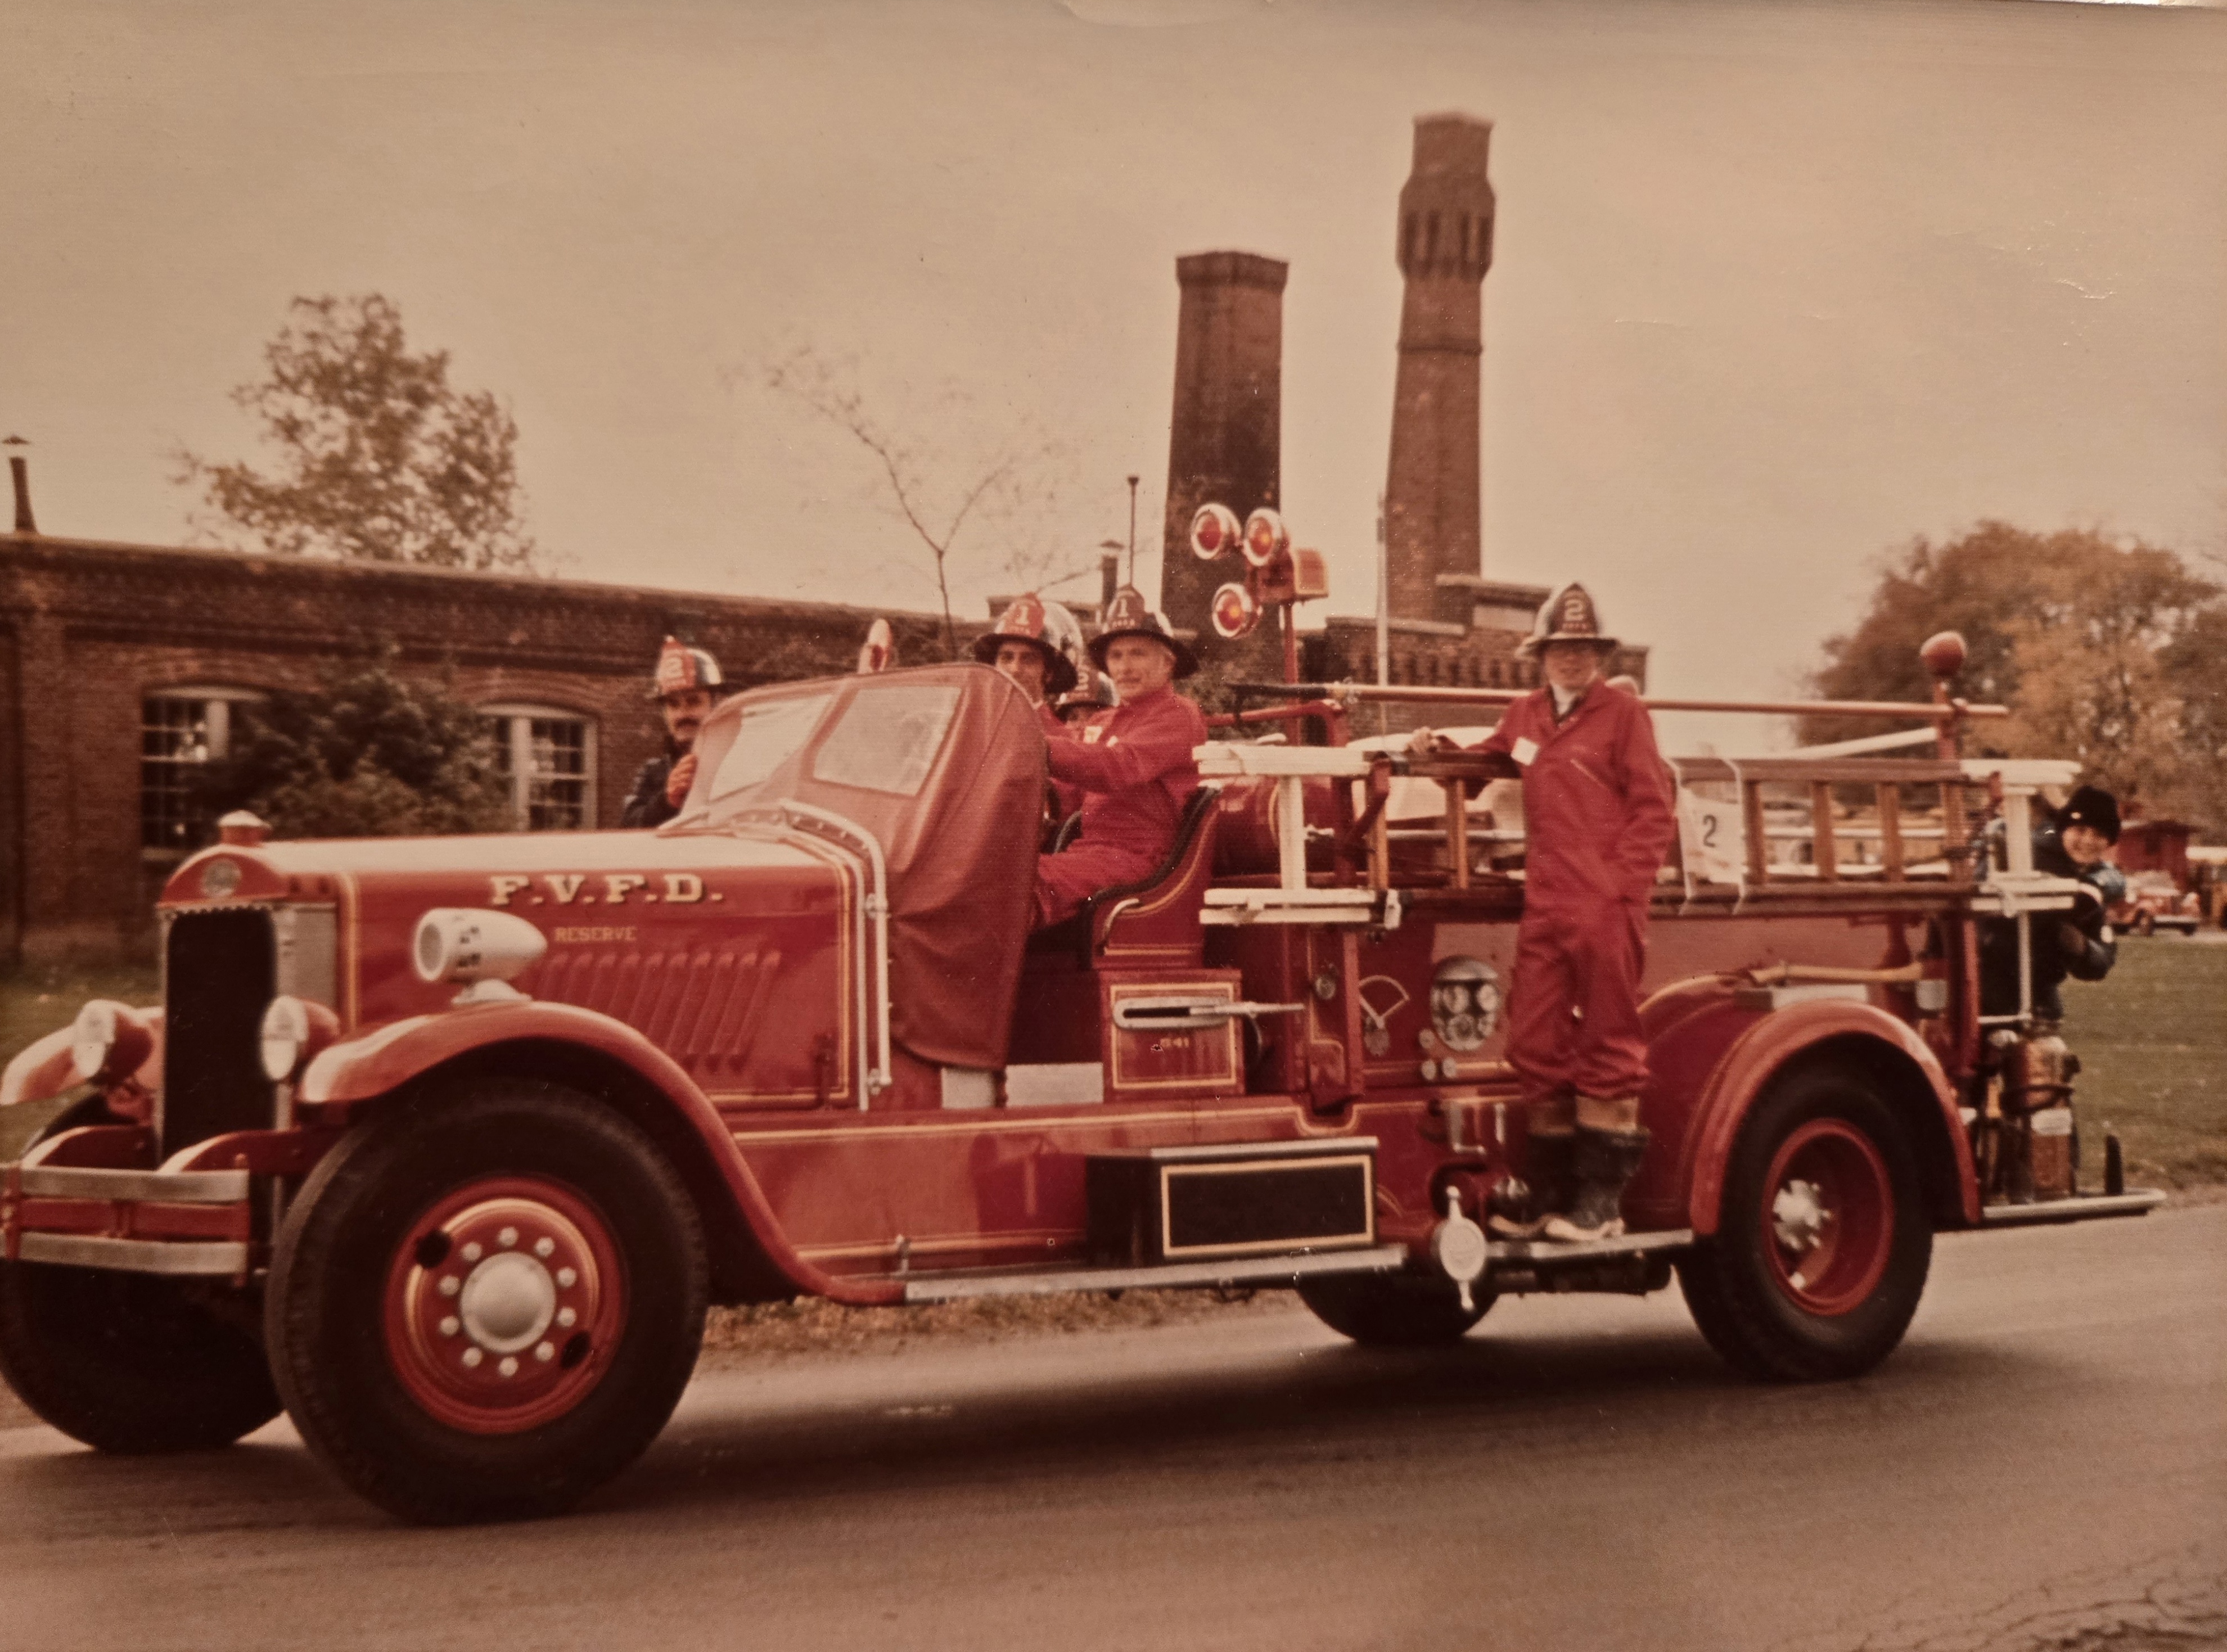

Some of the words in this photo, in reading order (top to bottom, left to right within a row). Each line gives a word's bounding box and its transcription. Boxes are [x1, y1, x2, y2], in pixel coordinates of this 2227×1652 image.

[1015, 605, 1030, 625] 1
[1702, 814, 1716, 848] 2
[490, 874, 723, 905] F.V.F.D.
[553, 927, 637, 942] RESERVE
